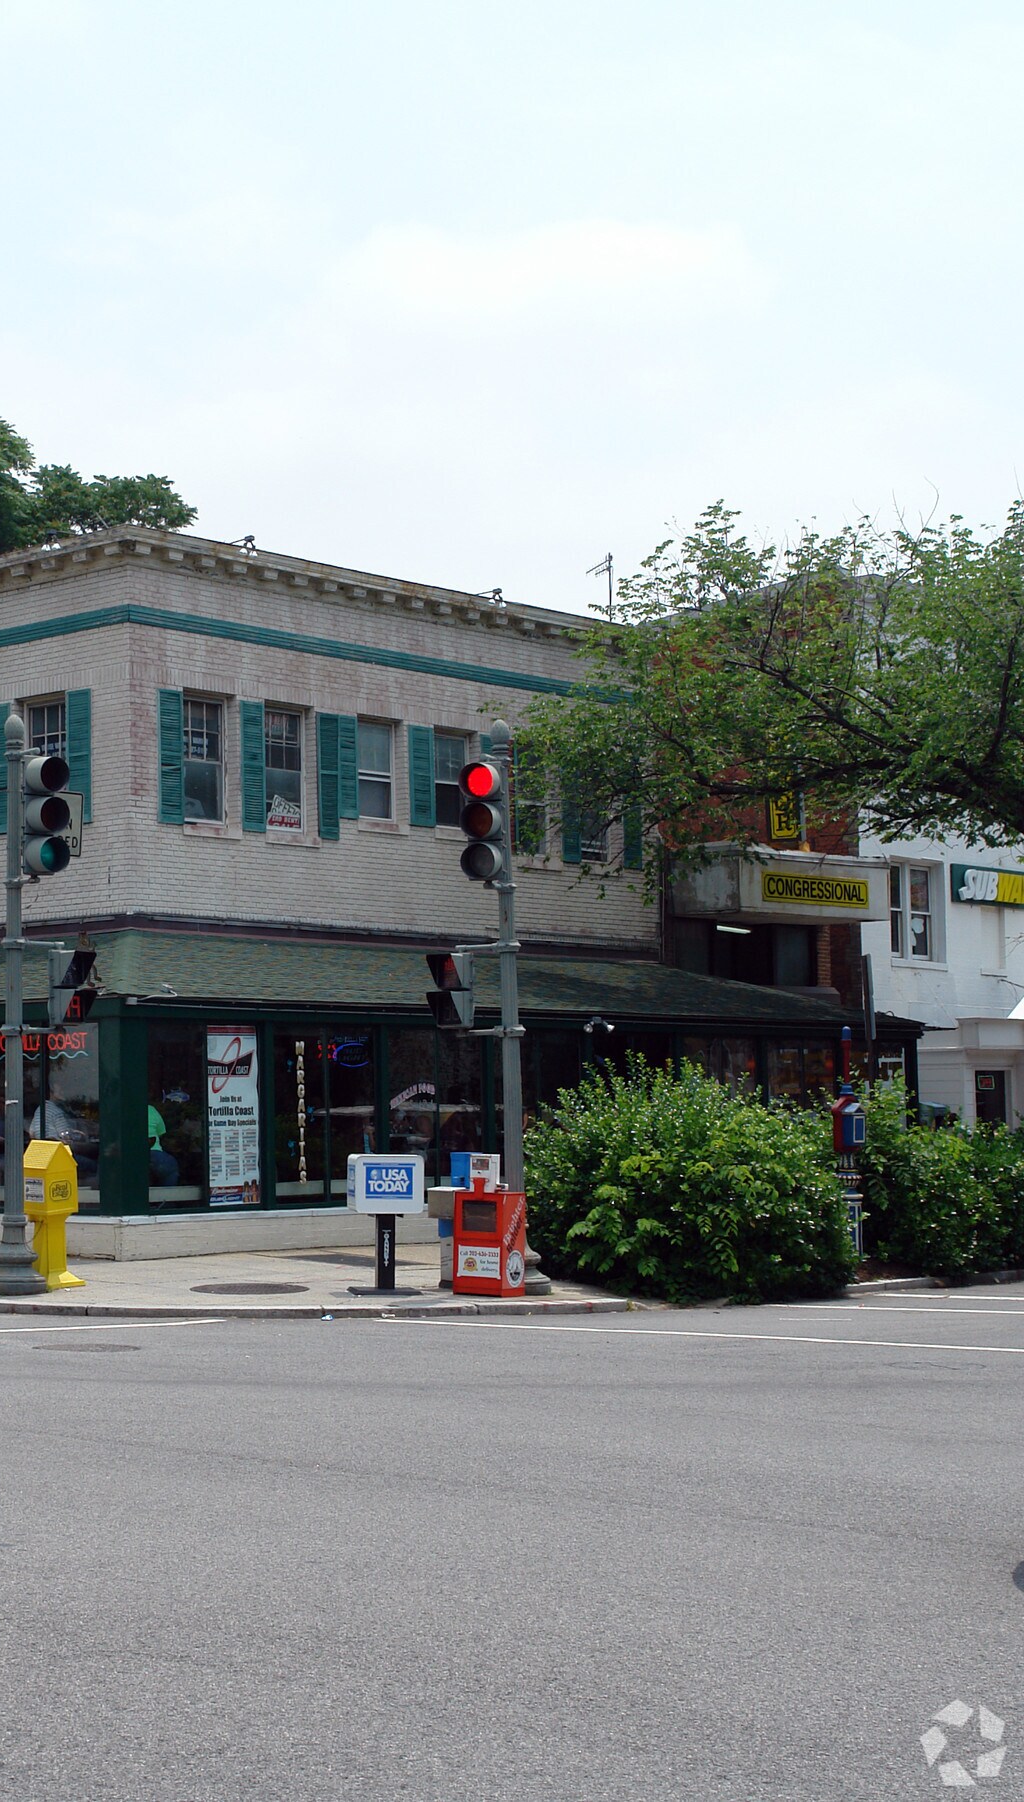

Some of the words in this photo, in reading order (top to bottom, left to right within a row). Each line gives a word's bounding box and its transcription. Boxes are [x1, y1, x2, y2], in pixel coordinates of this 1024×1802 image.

[767, 877, 865, 902] CONGRESSIONAL
[958, 869, 1024, 904] SUBWA
[47, 1032, 88, 1051] COAST
[236, 1066, 249, 1075] COAST
[208, 1106, 233, 1116] Tortilla
[235, 1106, 254, 1116] Coast
[295, 1041, 307, 1184] MARGARITAS
[382, 1169, 409, 1180] USA
[368, 1180, 410, 1192] TODAY
